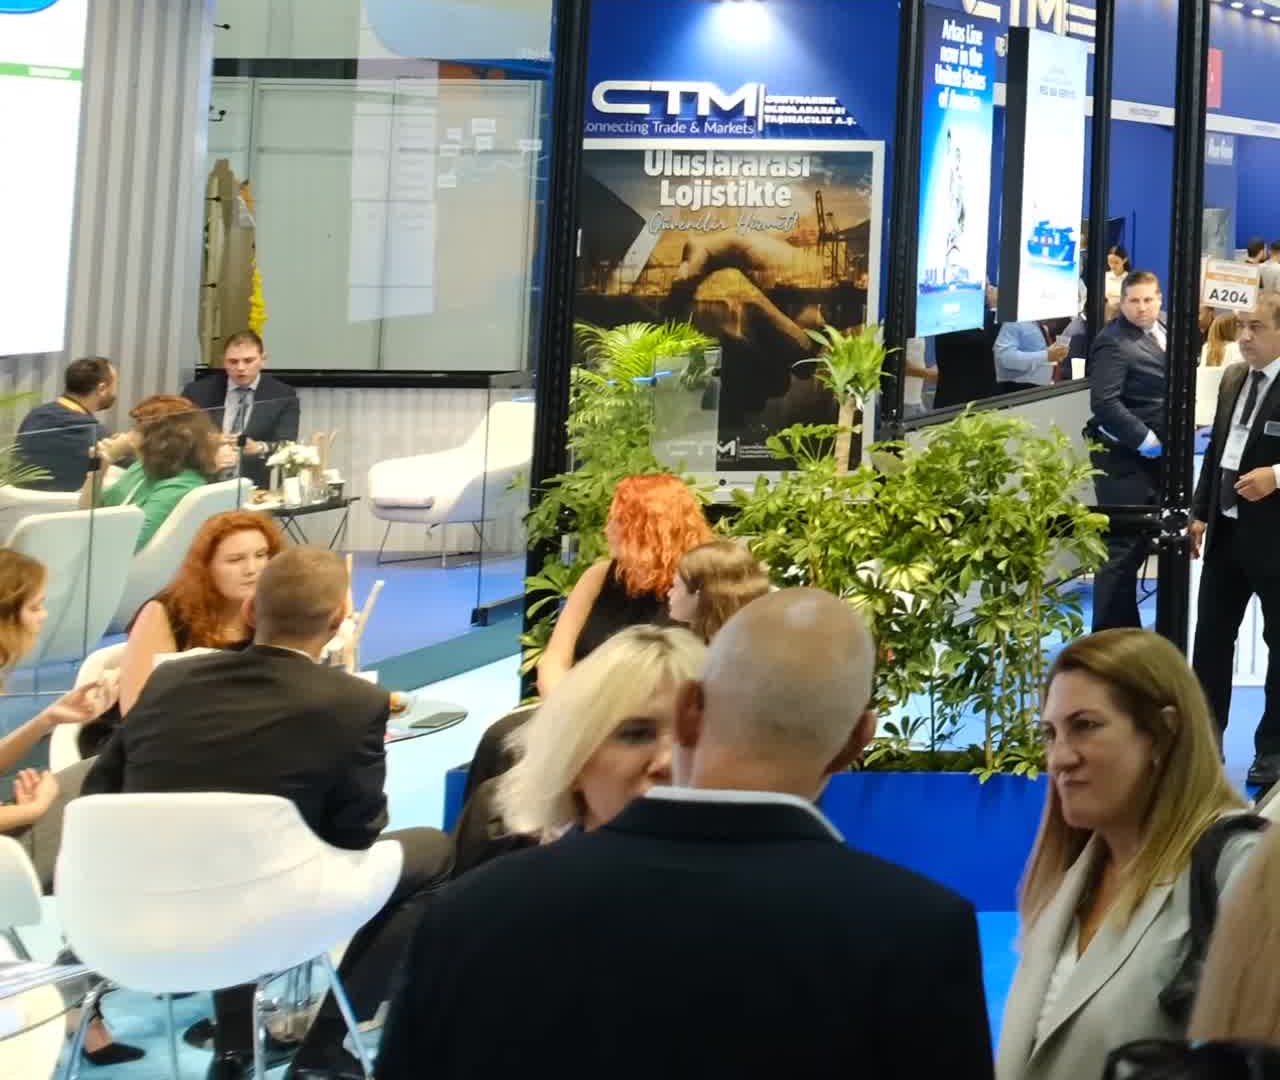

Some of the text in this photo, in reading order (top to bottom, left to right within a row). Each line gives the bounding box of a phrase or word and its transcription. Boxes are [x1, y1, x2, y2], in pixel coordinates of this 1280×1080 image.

[591, 80, 757, 116] CTM
[652, 121, 687, 134] Trade
[690, 122, 700, 134] &
[704, 121, 754, 135] Markets
[643, 149, 811, 177] Uluslararası
[659, 180, 793, 211] Lojistikte
[1208, 288, 1249, 305] A204
